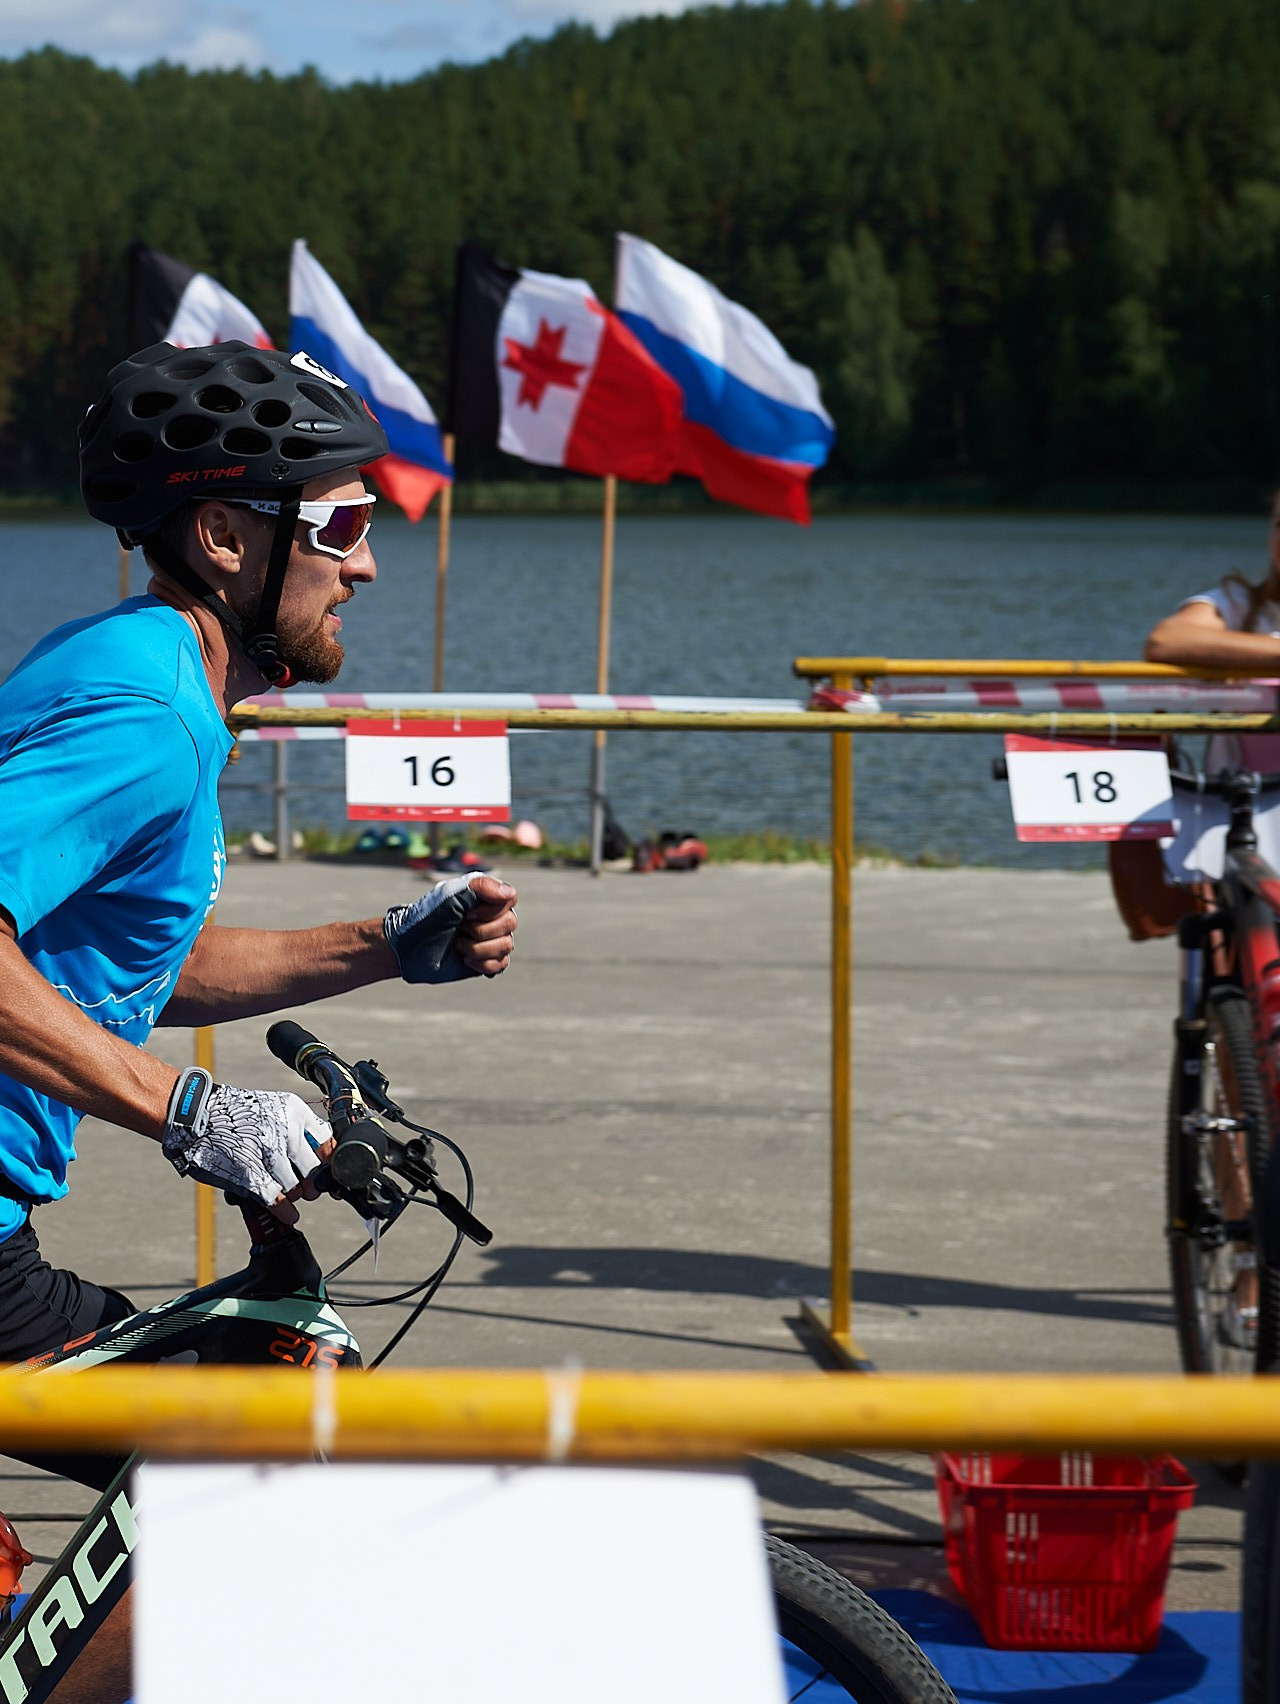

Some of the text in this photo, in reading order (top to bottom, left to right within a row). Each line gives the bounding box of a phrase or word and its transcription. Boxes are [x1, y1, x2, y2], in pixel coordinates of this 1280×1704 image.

[166, 465, 246, 484] SKI TIME
[403, 755, 455, 787] 16
[1064, 771, 1118, 803] 18
